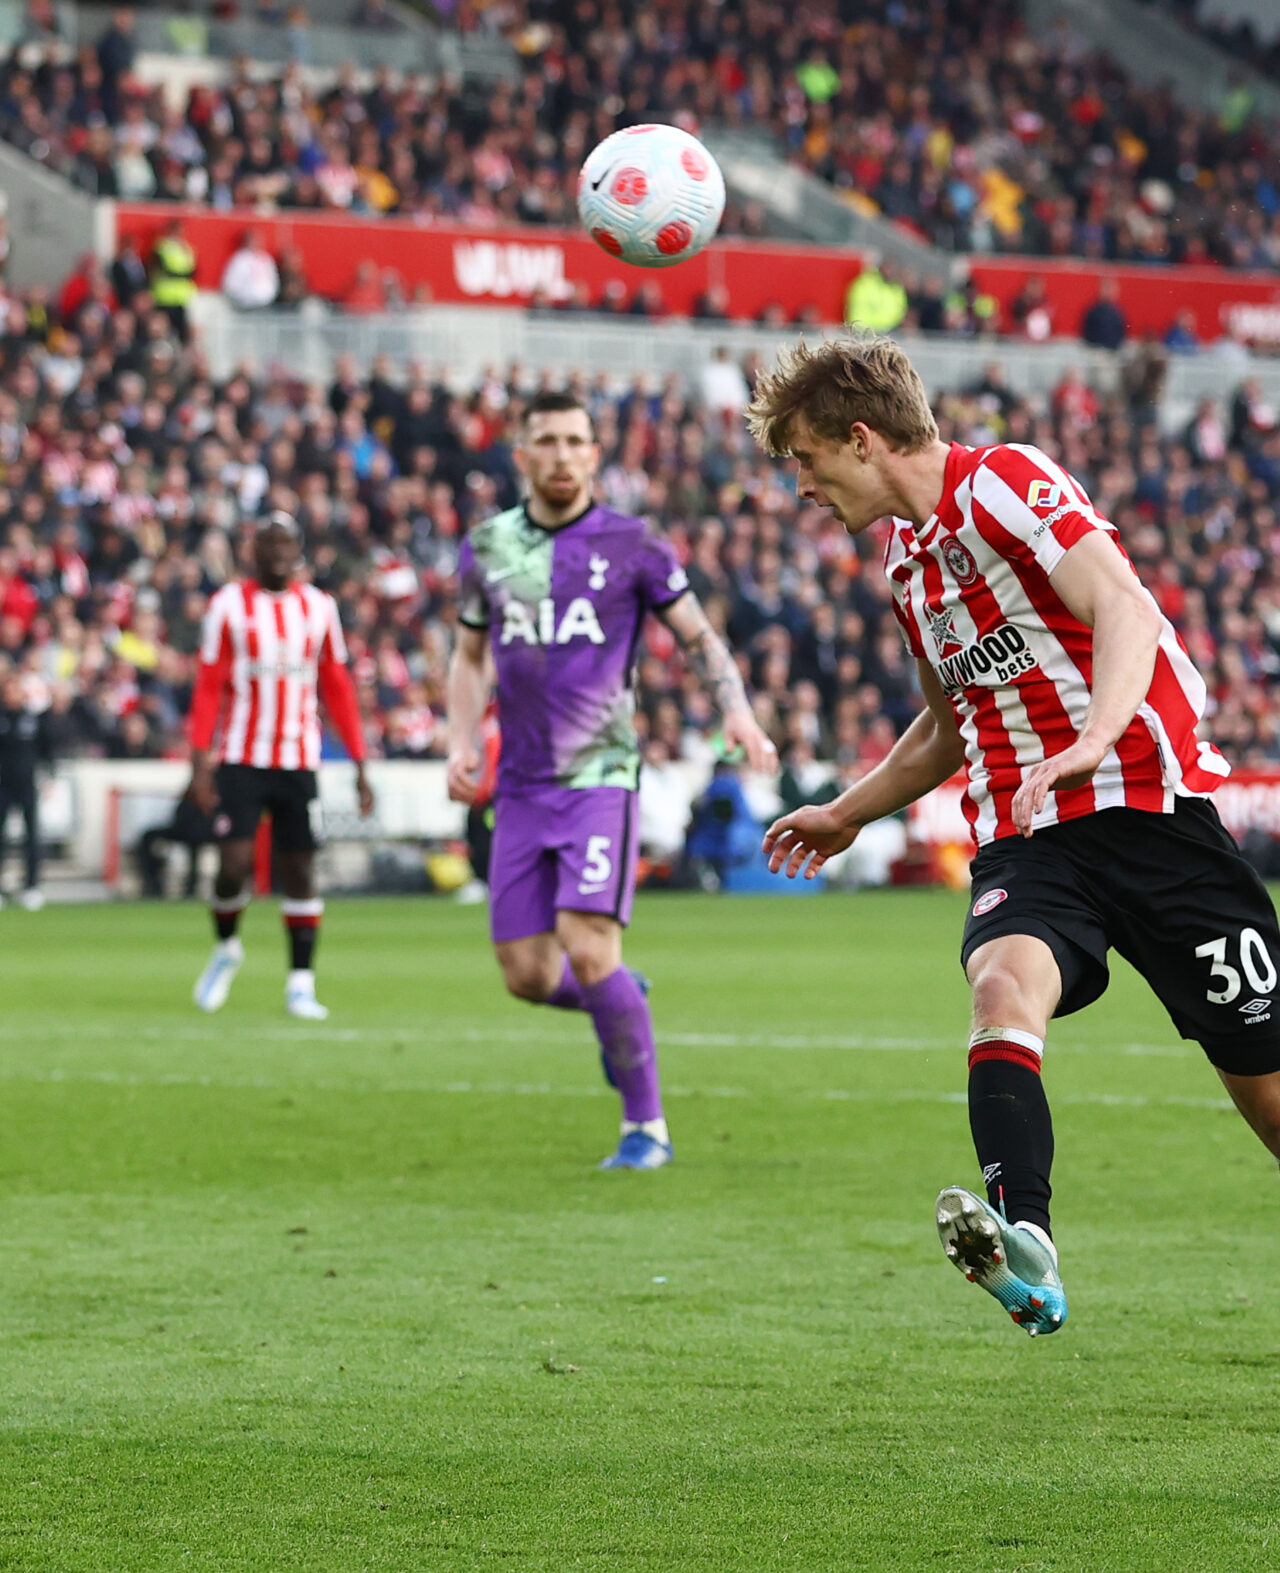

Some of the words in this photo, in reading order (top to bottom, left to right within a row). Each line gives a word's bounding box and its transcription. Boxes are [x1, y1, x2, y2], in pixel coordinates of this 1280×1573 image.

[500, 598, 606, 645] AIA
[937, 625, 1025, 696] LYWOOD
[994, 652, 1035, 682] bets
[582, 835, 611, 883] 5
[1195, 927, 1277, 1005] 30
[1244, 1012, 1271, 1025] umbro
